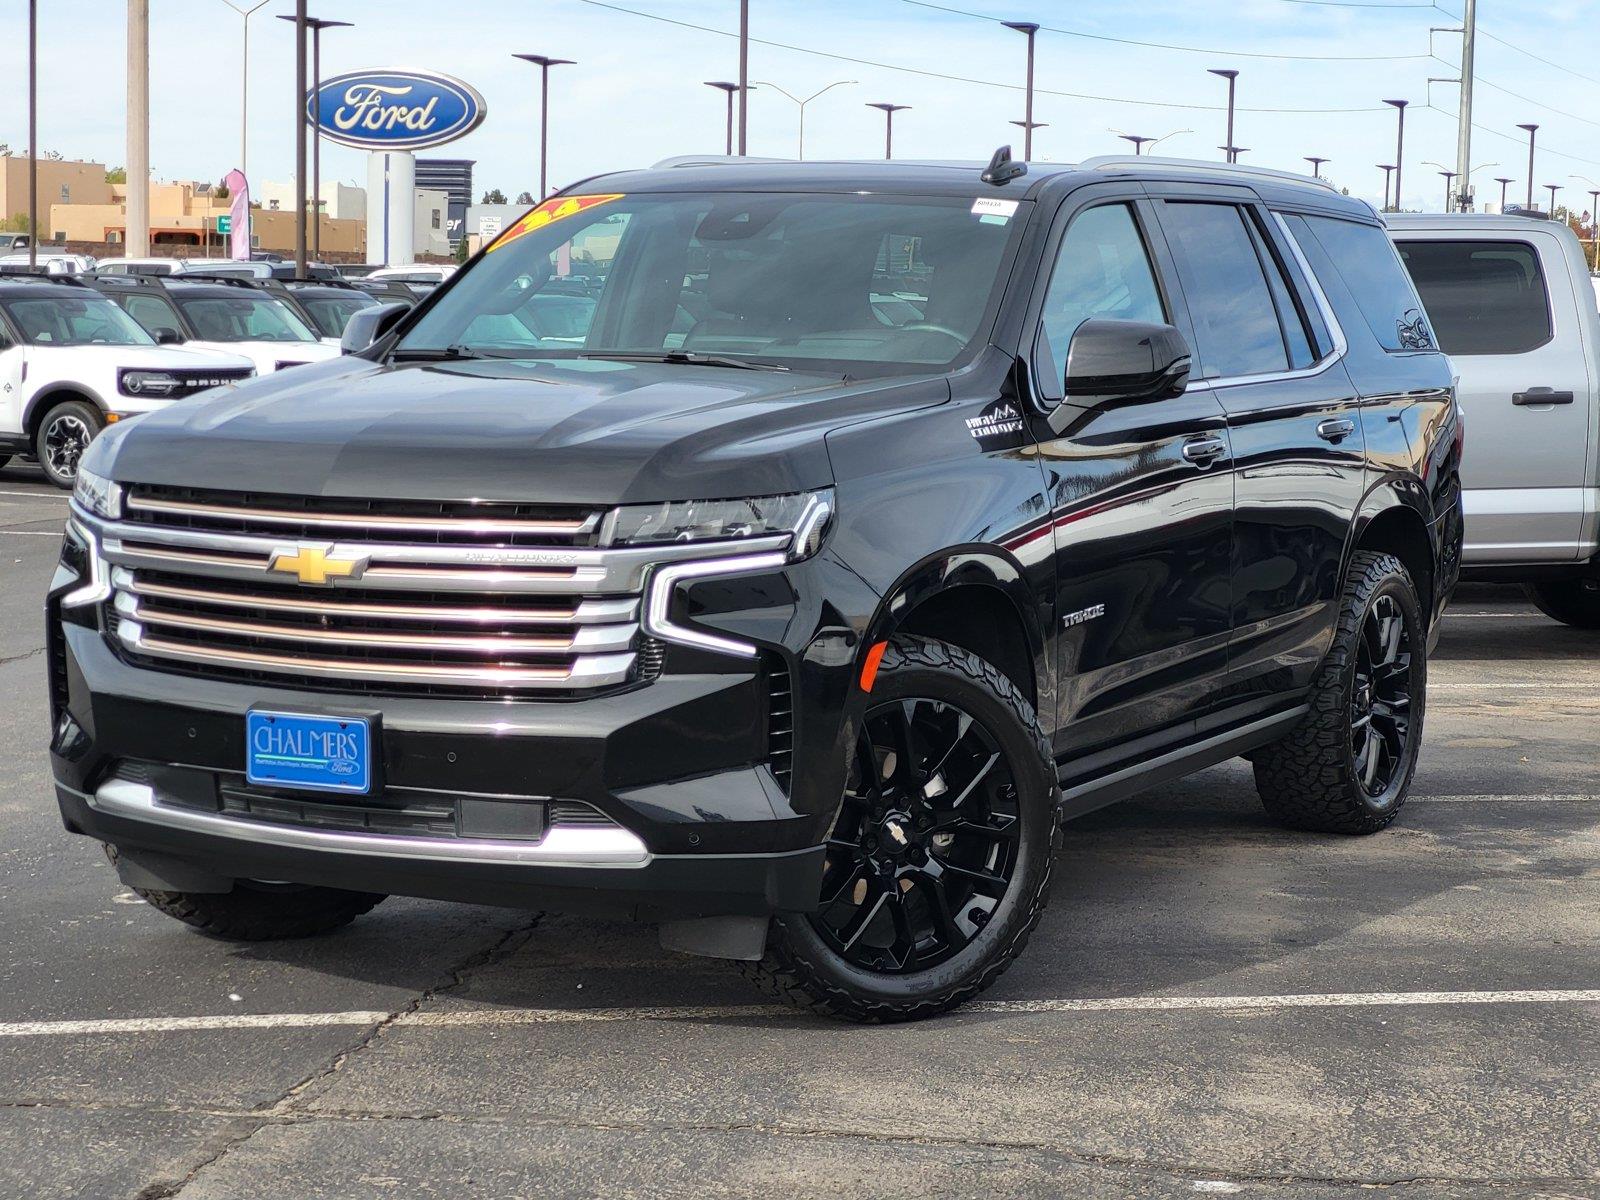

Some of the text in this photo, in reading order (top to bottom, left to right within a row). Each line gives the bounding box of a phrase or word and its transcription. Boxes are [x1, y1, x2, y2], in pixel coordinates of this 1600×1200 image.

[334, 84, 439, 130] Ford
[970, 420, 1023, 437] COUNTRY
[1062, 603, 1105, 628] TAHOE
[254, 725, 358, 760] CHALMERS
[331, 761, 354, 774] Ford
